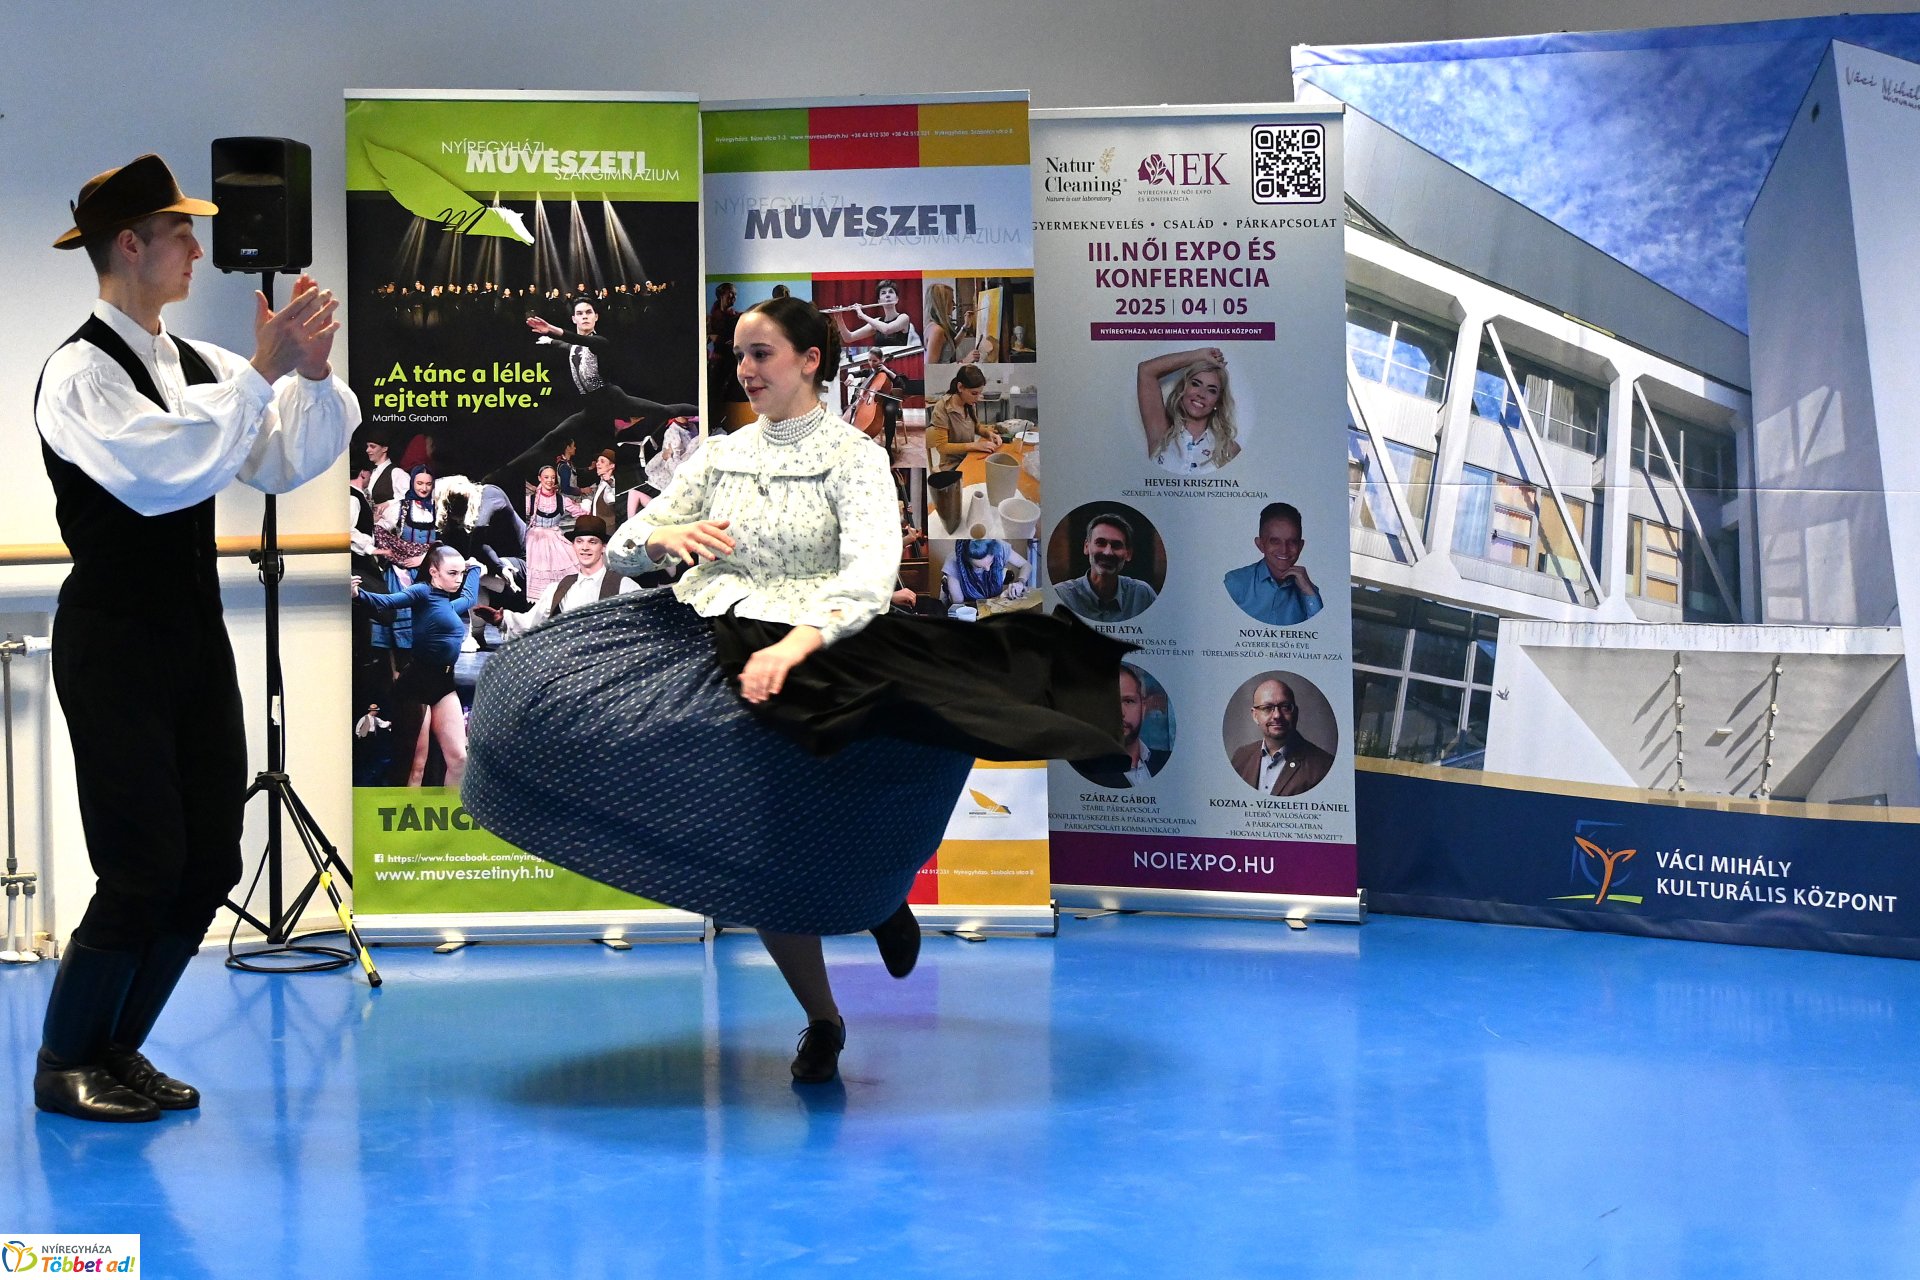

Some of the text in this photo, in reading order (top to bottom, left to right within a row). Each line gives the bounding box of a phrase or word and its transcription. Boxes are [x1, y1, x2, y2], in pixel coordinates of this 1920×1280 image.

[1045, 157, 1095, 174] Natur
[1032, 216, 1336, 230] GYERMEKNEVELÉS CSALÁD PÁRKAPCSOLAT
[1175, 240, 1241, 262] EXPO
[1248, 237, 1276, 260] ÉS
[1096, 267, 1270, 288] KONFERENCIA
[1115, 298, 1248, 316] 2025 04 05
[1100, 328, 1148, 336] NYÍREGYHÁZA,
[413, 362, 466, 383] tánc
[472, 369, 486, 383] a
[493, 362, 550, 383] lélek
[374, 388, 448, 413] rejtett
[372, 414, 448, 422] Martha Graham
[1144, 478, 1240, 488] HEVESI KRISZTINA
[1162, 490, 1206, 498] VONZALOM
[1118, 626, 1144, 634] ATYA
[1240, 628, 1318, 640] NOVÁK FERENC
[1169, 638, 1177, 646] ÉS
[1080, 794, 1156, 804] SZÁRAZ GÁBOR
[1209, 799, 1248, 808] KOZMA
[1256, 800, 1309, 811] VÍZKELETI
[1312, 802, 1350, 813] DÁNIEL
[378, 804, 480, 832] TÁNC
[1134, 851, 1274, 874] NOIEXPO.HU
[1656, 848, 1792, 878] VÁCI MIHÁLY
[376, 866, 554, 882] www.muveszetinyh.hu
[1656, 878, 1898, 912] KULTURÁLIS KÖZPONT
